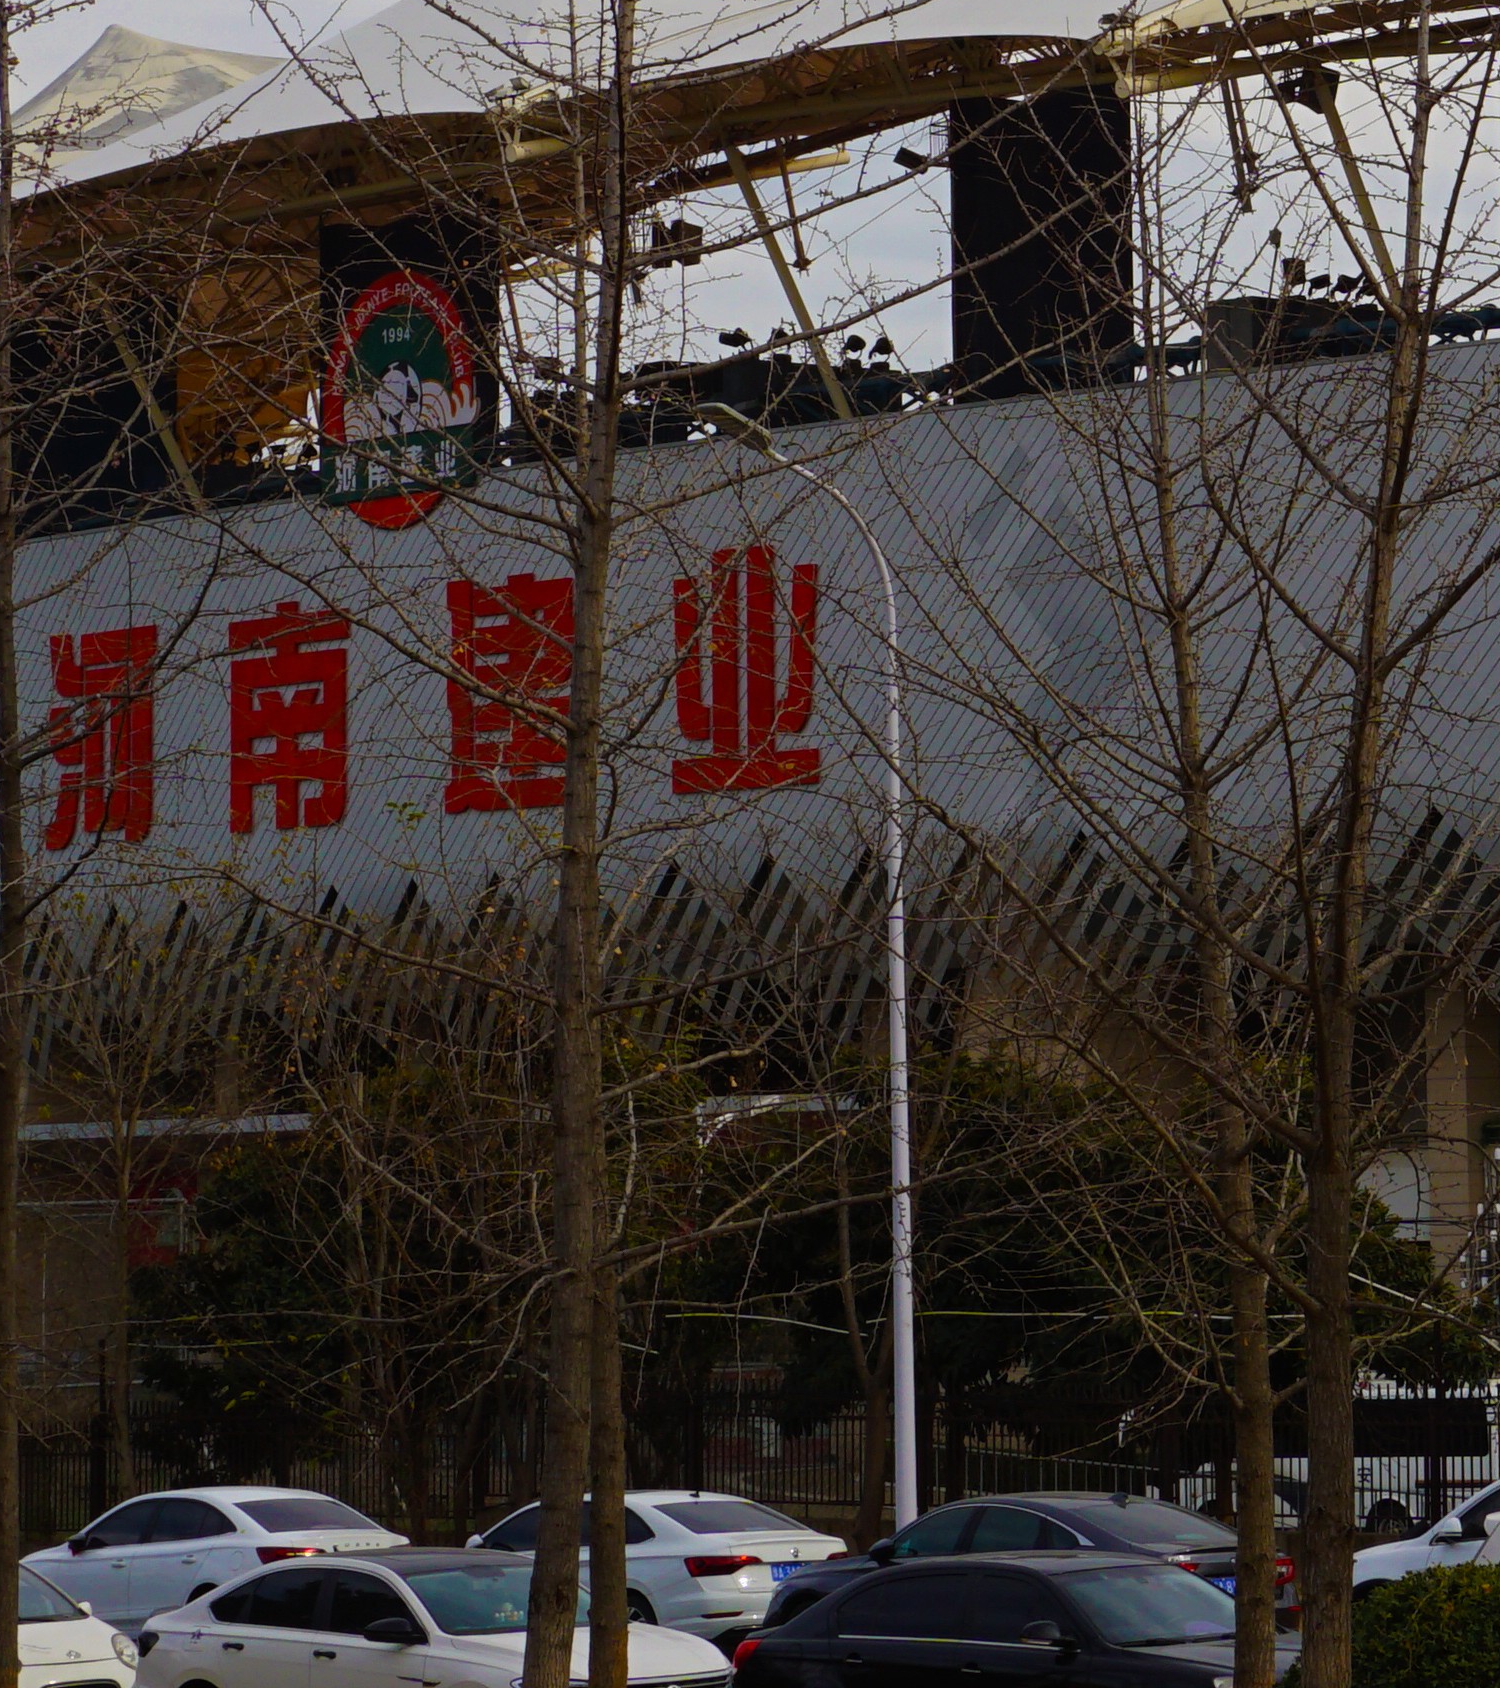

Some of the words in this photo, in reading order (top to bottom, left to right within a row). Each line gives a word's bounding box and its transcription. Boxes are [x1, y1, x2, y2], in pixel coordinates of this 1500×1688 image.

[381, 326, 411, 345] 1994
[44, 545, 822, 852] 河南建业
